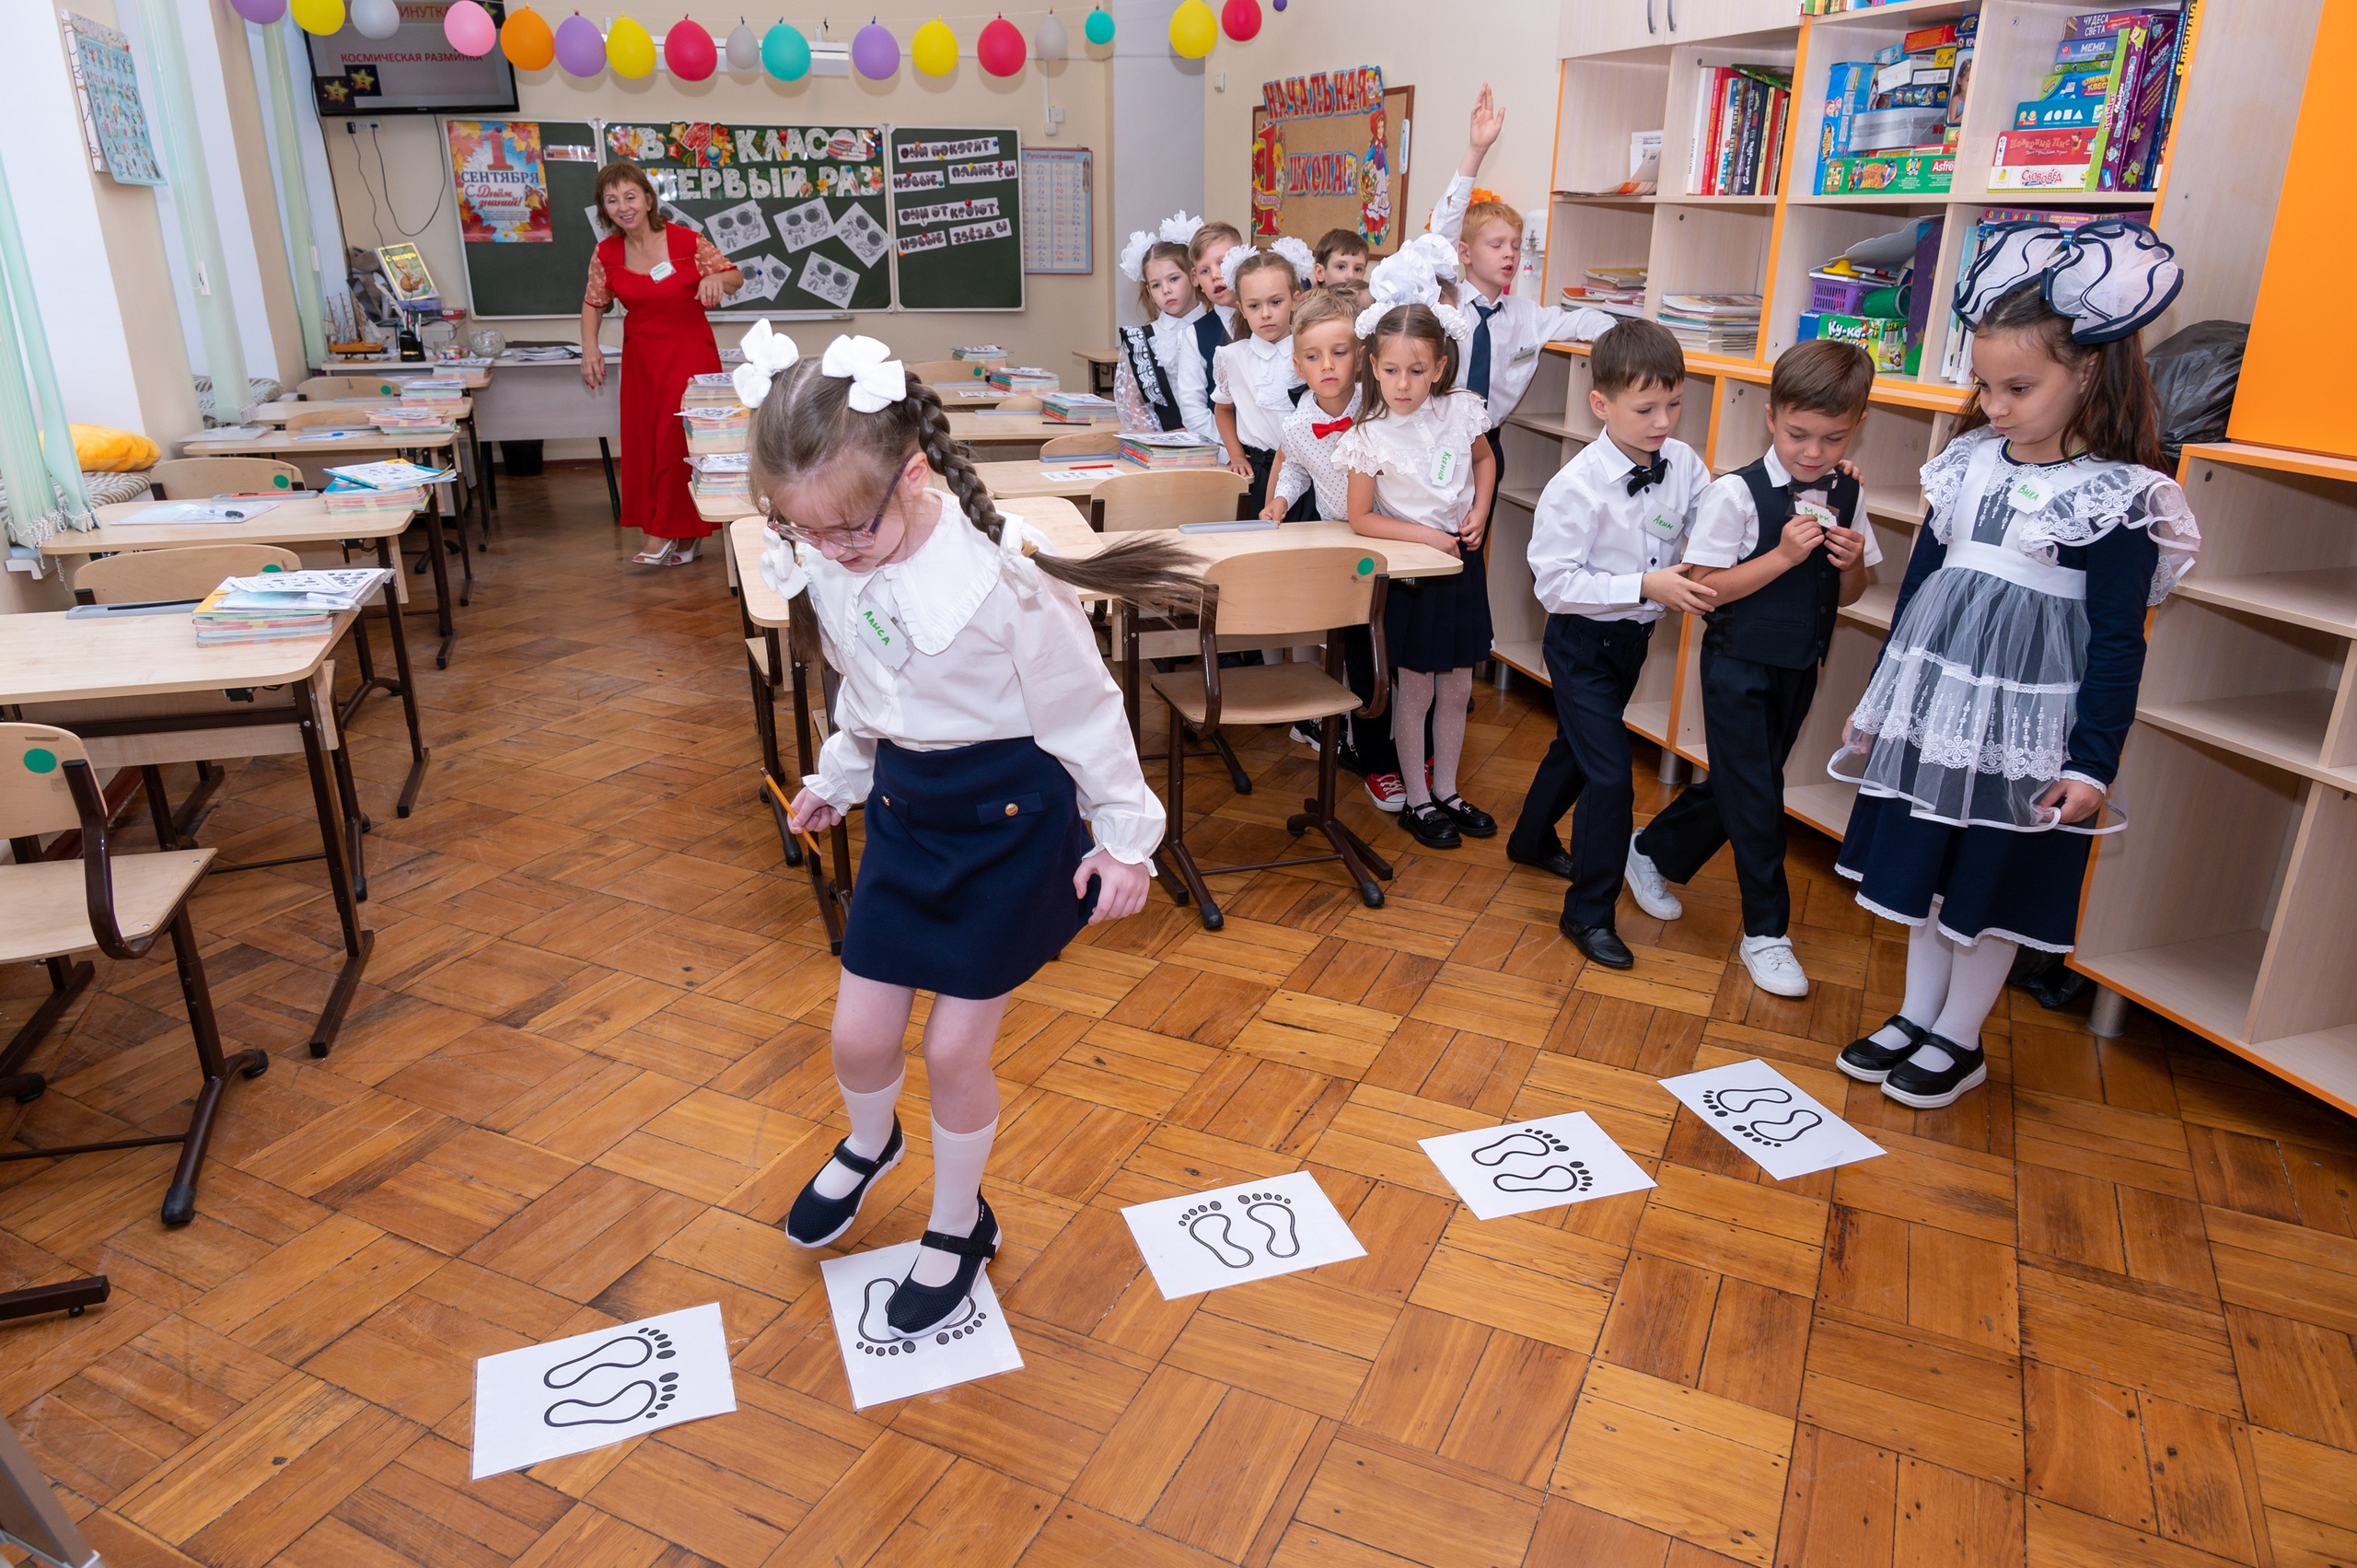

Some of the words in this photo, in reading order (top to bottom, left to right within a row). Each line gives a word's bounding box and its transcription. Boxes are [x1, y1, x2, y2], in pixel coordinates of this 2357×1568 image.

[400, 6, 449, 17] ИНУТК
[2084, 14, 2108, 26] ЧУДЕСА
[2084, 25, 2106, 37] СВЕТА
[2081, 41, 2106, 52] МЕМО
[341, 52, 422, 64] КОСМИЧЕСКАЯ
[425, 52, 483, 63] РАЗМИНКА
[1263, 65, 1370, 120] НАЧАЛЬНАЯ
[483, 127, 514, 170] 1
[636, 127, 665, 159] В
[680, 122, 712, 168] 1
[900, 145, 929, 159] ОНИ
[931, 139, 990, 157] ПОКОРЯТ
[1728, 129, 1736, 160] РОДНАЯ
[2052, 137, 2071, 149] Лис
[1027, 152, 1050, 160] Русский
[460, 171, 540, 183] СЕНТЯБРЯ
[646, 166, 807, 200] ПЕРВЫЙ
[818, 165, 879, 197] РАЗ
[893, 174, 938, 189] НОВЫЕ
[951, 164, 1016, 179] ПЛАНЕТЫ
[1257, 123, 1280, 236] 1
[464, 184, 475, 198] С
[477, 184, 513, 198] Днём
[478, 196, 523, 210] знаний!
[901, 207, 929, 222] ОНИ
[900, 232, 944, 250] НОВЫЕ
[953, 220, 1007, 244] ЗВЁЗДЫ
